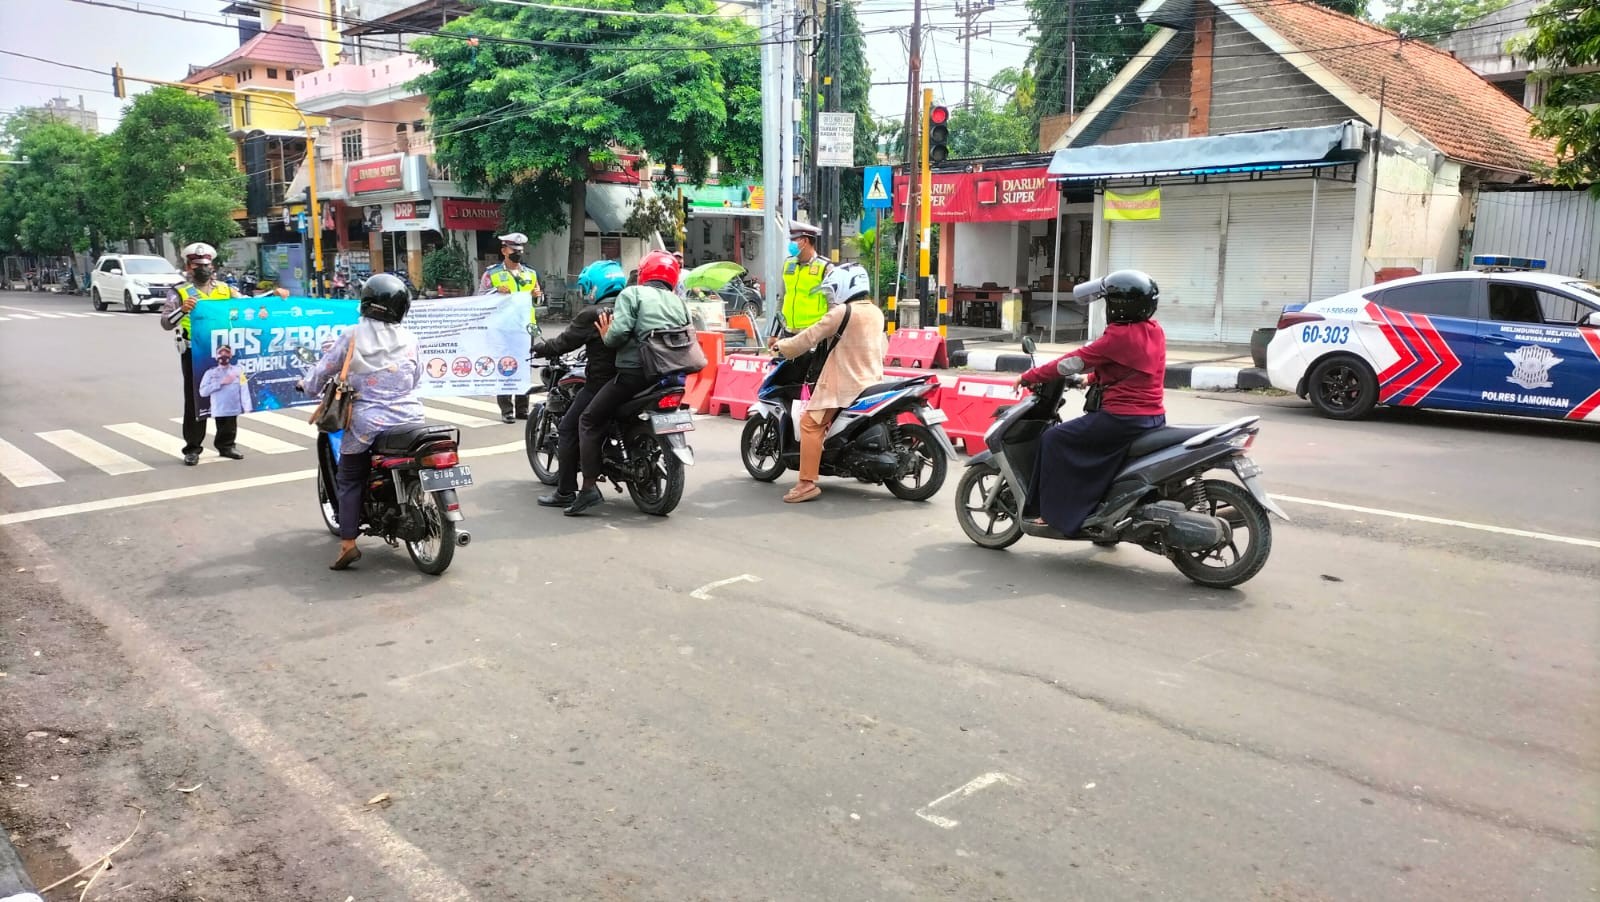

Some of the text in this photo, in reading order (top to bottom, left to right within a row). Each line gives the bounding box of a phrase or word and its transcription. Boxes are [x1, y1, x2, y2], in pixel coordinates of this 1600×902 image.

[1002, 177, 1045, 191] DJARUM
[1002, 191, 1035, 204] SUPER
[395, 203, 413, 217] DRP
[1302, 324, 1350, 345] 60-303
[1500, 325, 1581, 338] MELINDUNGI, MELAYANI
[1514, 334, 1562, 344] MASYARAKAT
[1481, 390, 1569, 408] POLRES LAMONGAN
